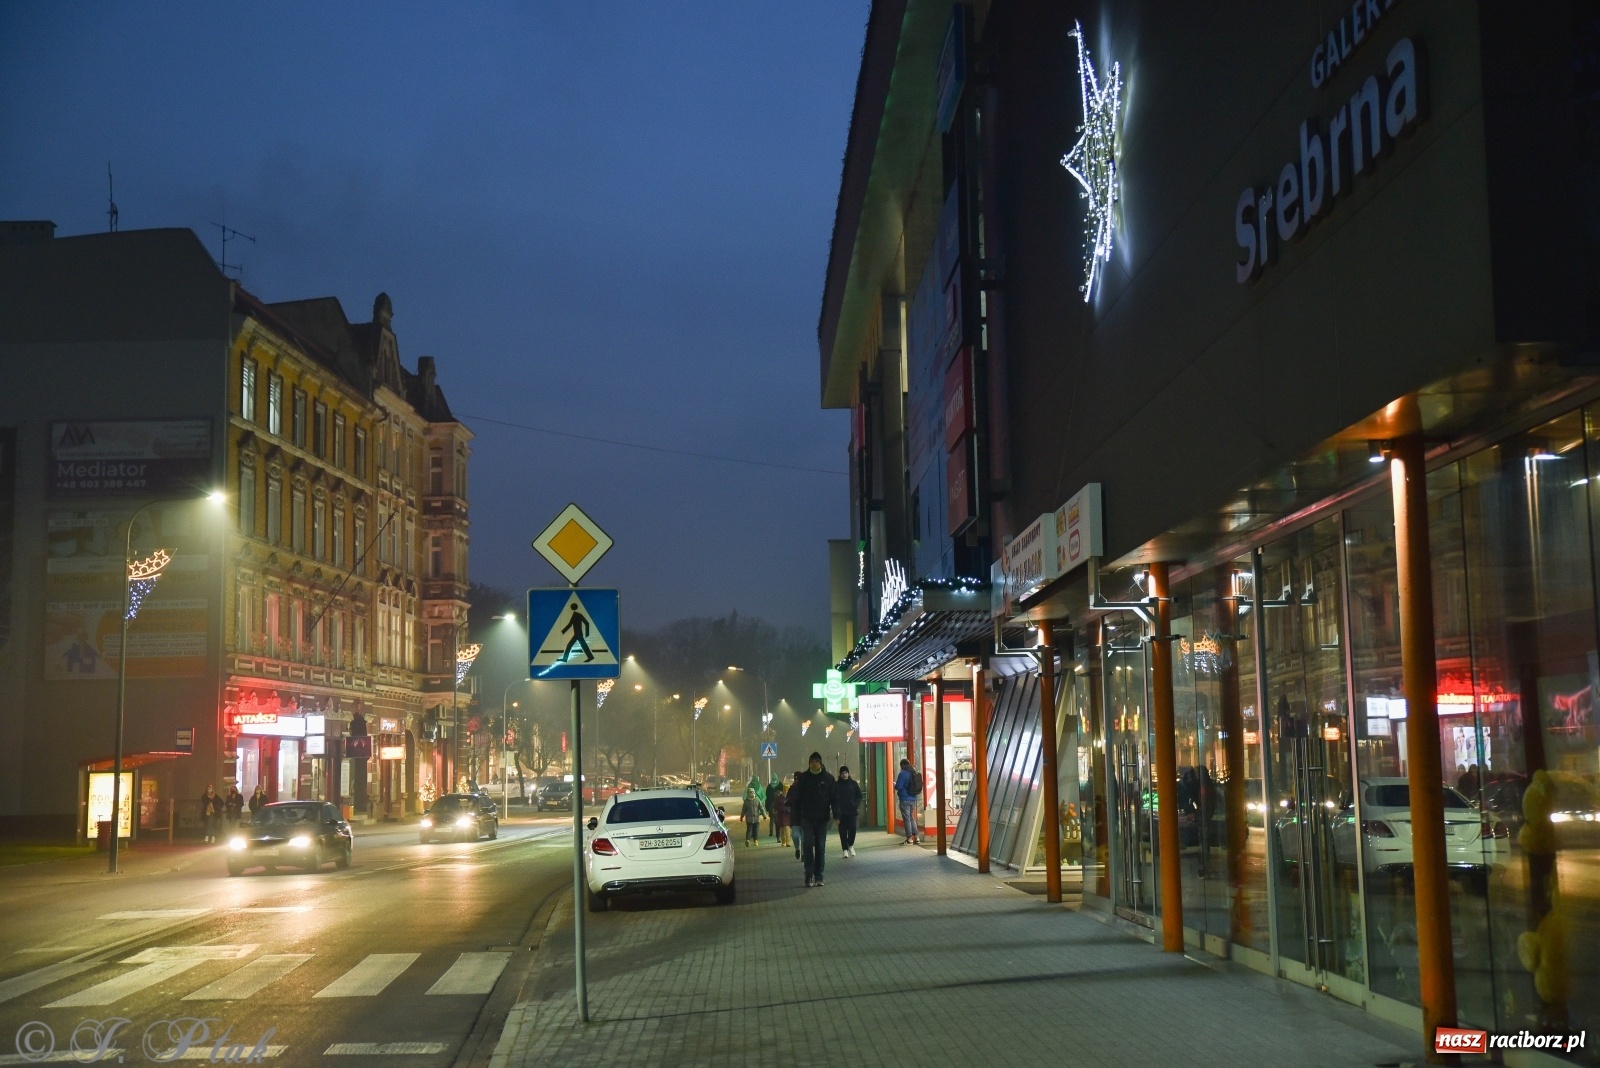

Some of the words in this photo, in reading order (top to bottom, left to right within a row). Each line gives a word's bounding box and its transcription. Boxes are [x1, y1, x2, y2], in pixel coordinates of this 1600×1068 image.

[1235, 37, 1418, 284] Srebrna
[57, 461, 147, 477] Mediator
[56, 480, 76, 488] +48
[79, 480, 99, 488] 603
[126, 479, 147, 488] 467
